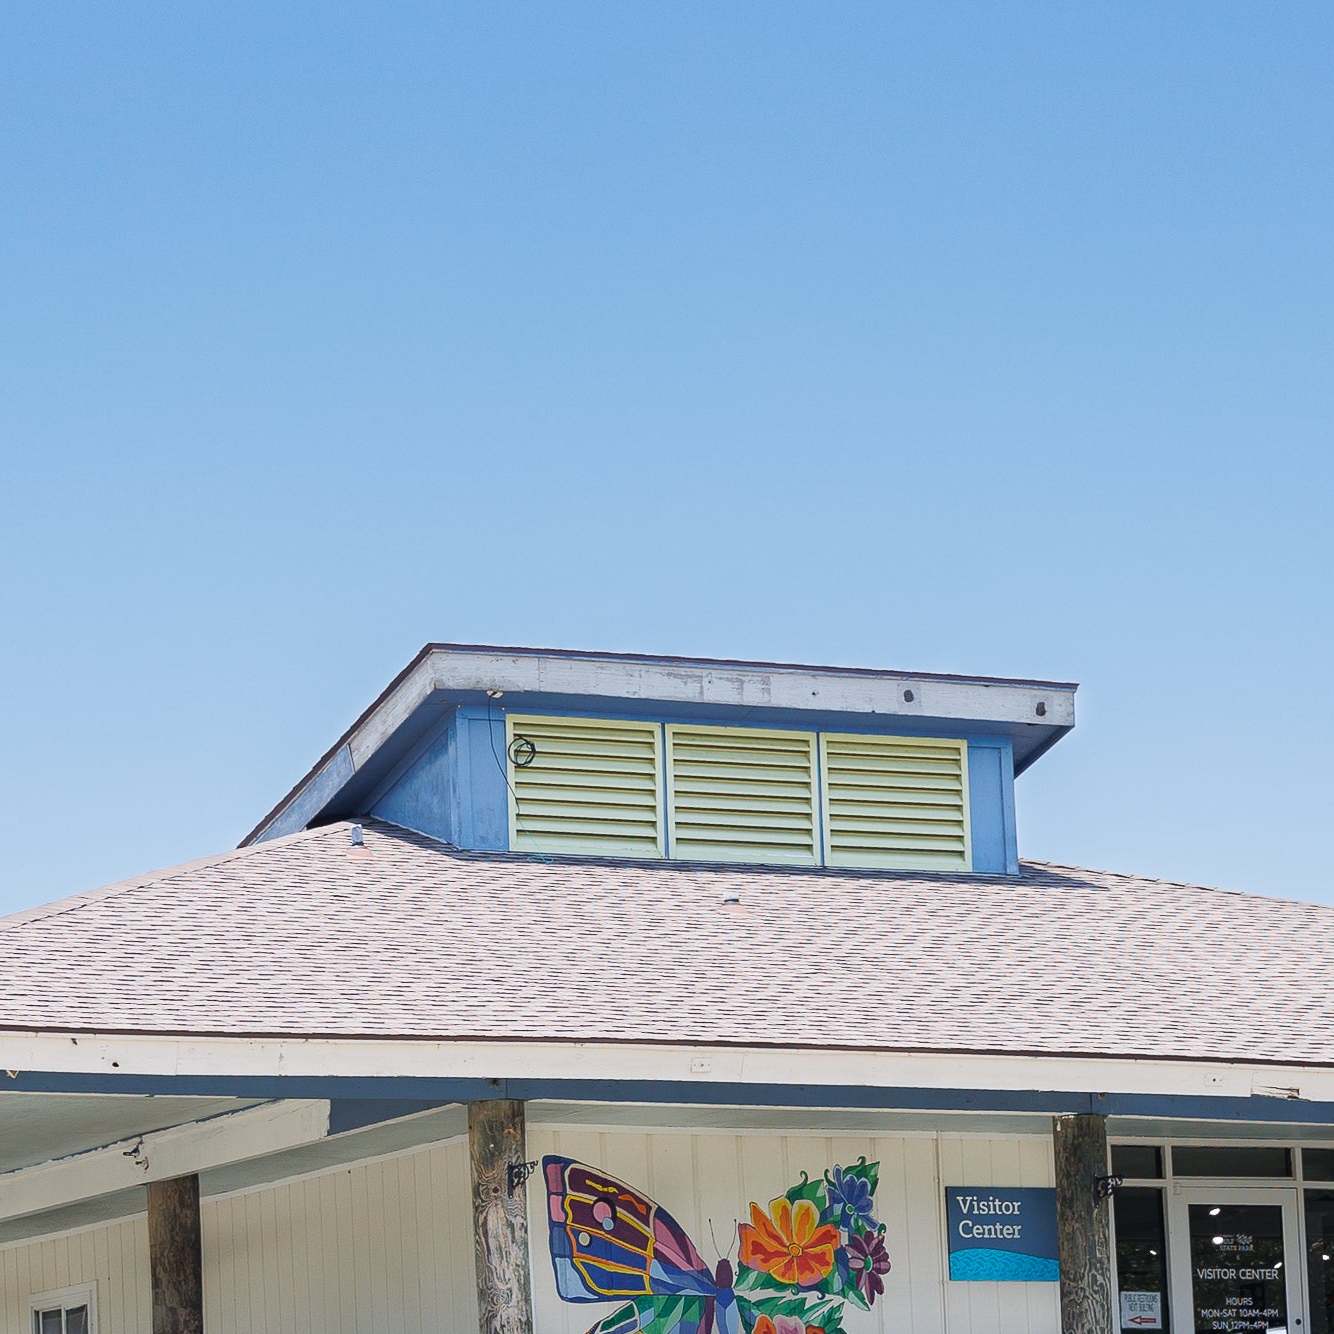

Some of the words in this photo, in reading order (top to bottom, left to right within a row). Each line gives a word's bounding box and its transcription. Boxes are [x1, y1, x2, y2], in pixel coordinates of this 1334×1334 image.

[956, 1196, 1021, 1215] Visitor
[958, 1220, 1022, 1239] Center
[1197, 1268, 1237, 1280] VISITOR
[1238, 1268, 1279, 1280] CENTER
[1225, 1297, 1254, 1306] HOURS
[1201, 1308, 1237, 1318] MON-SAT
[1239, 1308, 1279, 1318] 10AM-4PM
[1212, 1321, 1229, 1330] SUN
